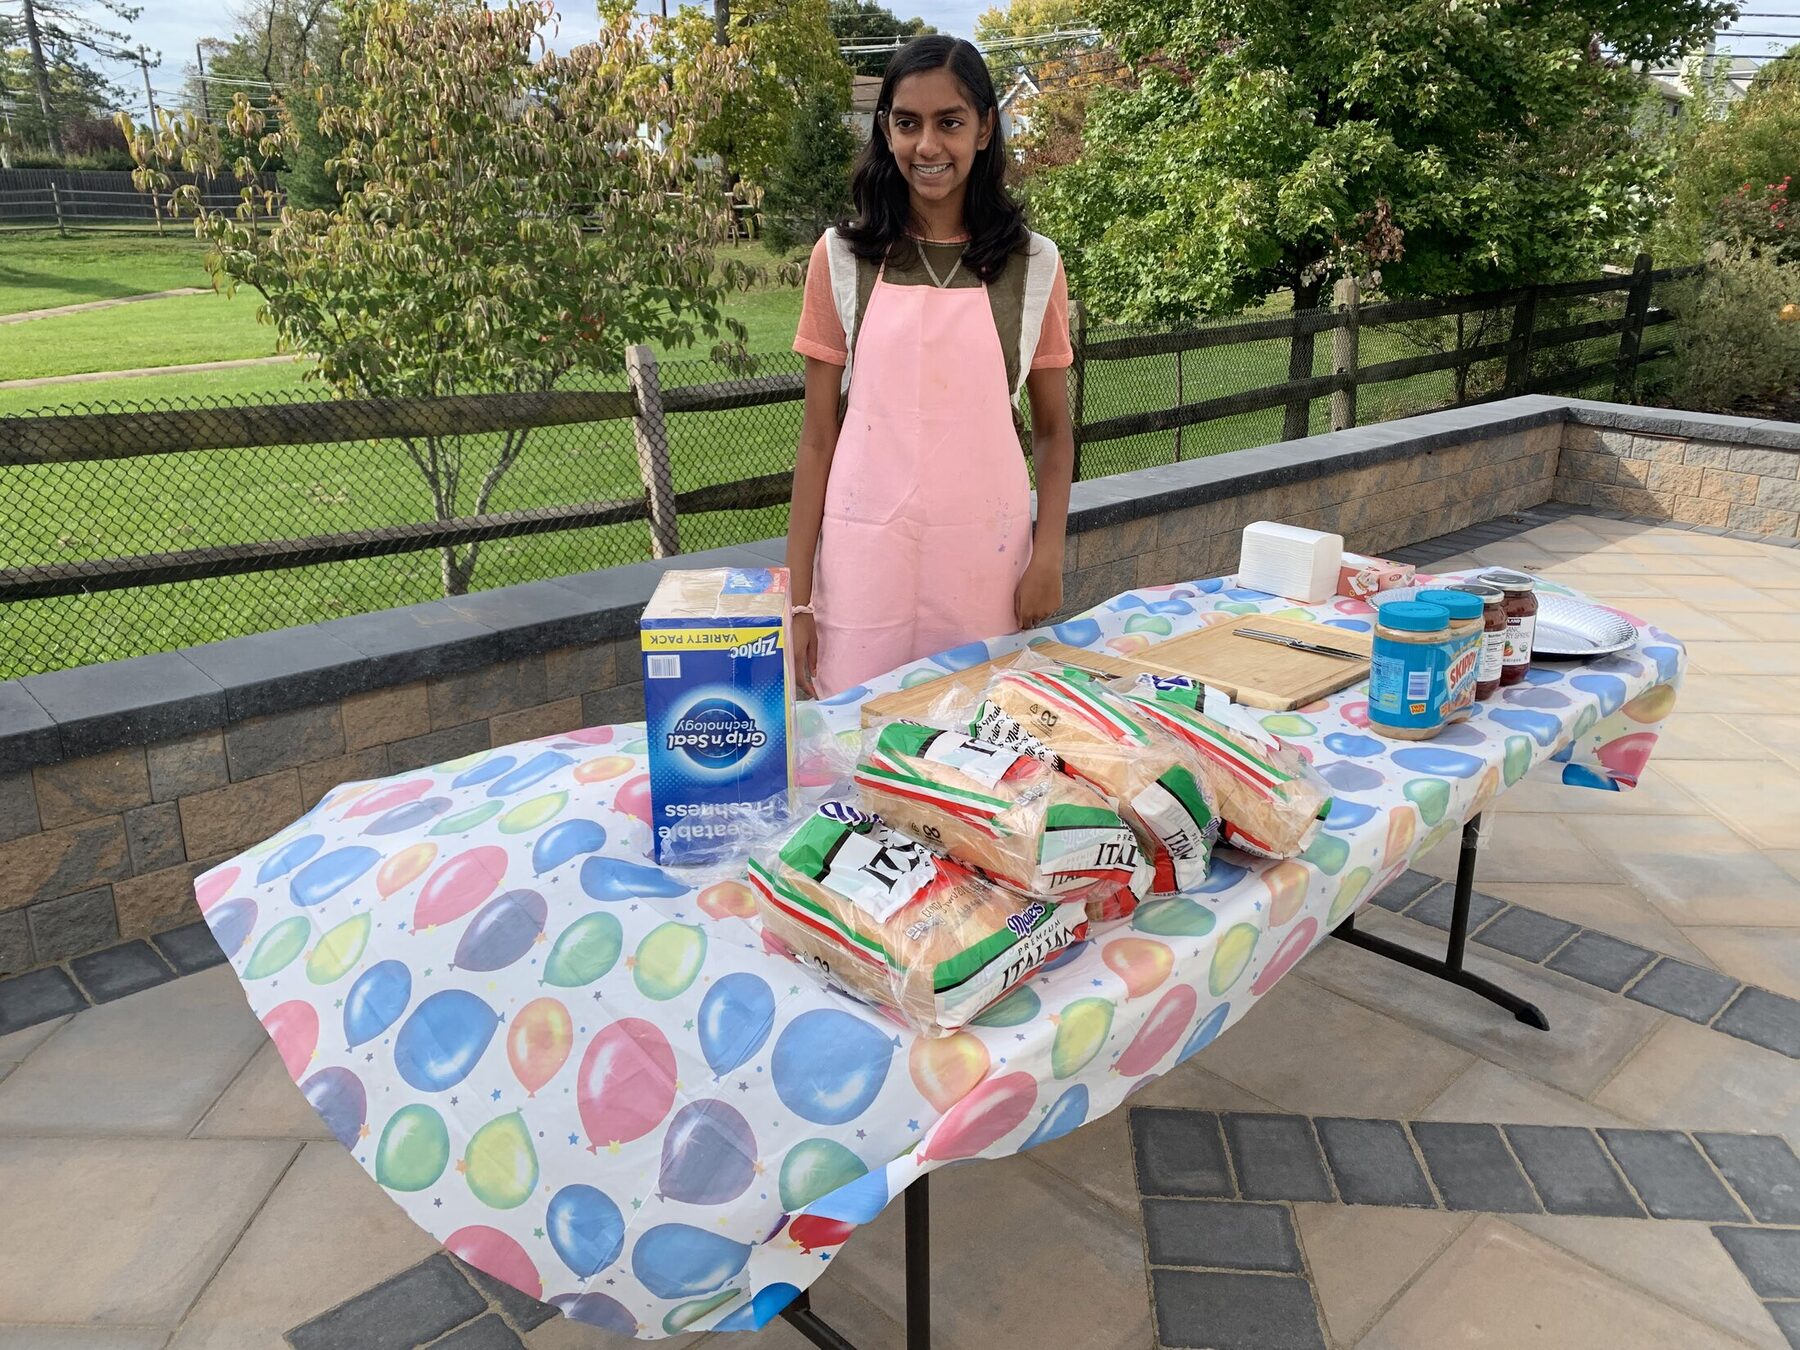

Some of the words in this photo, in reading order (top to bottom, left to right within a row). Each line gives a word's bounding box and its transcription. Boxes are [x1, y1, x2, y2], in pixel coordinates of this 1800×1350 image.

[650, 635, 683, 645] PACK
[687, 634, 739, 645] VARIETY
[729, 634, 777, 660] Ziploc
[676, 718, 757, 732] Technology
[668, 732, 709, 749] Seal
[1018, 919, 1062, 956] PREMIUM
